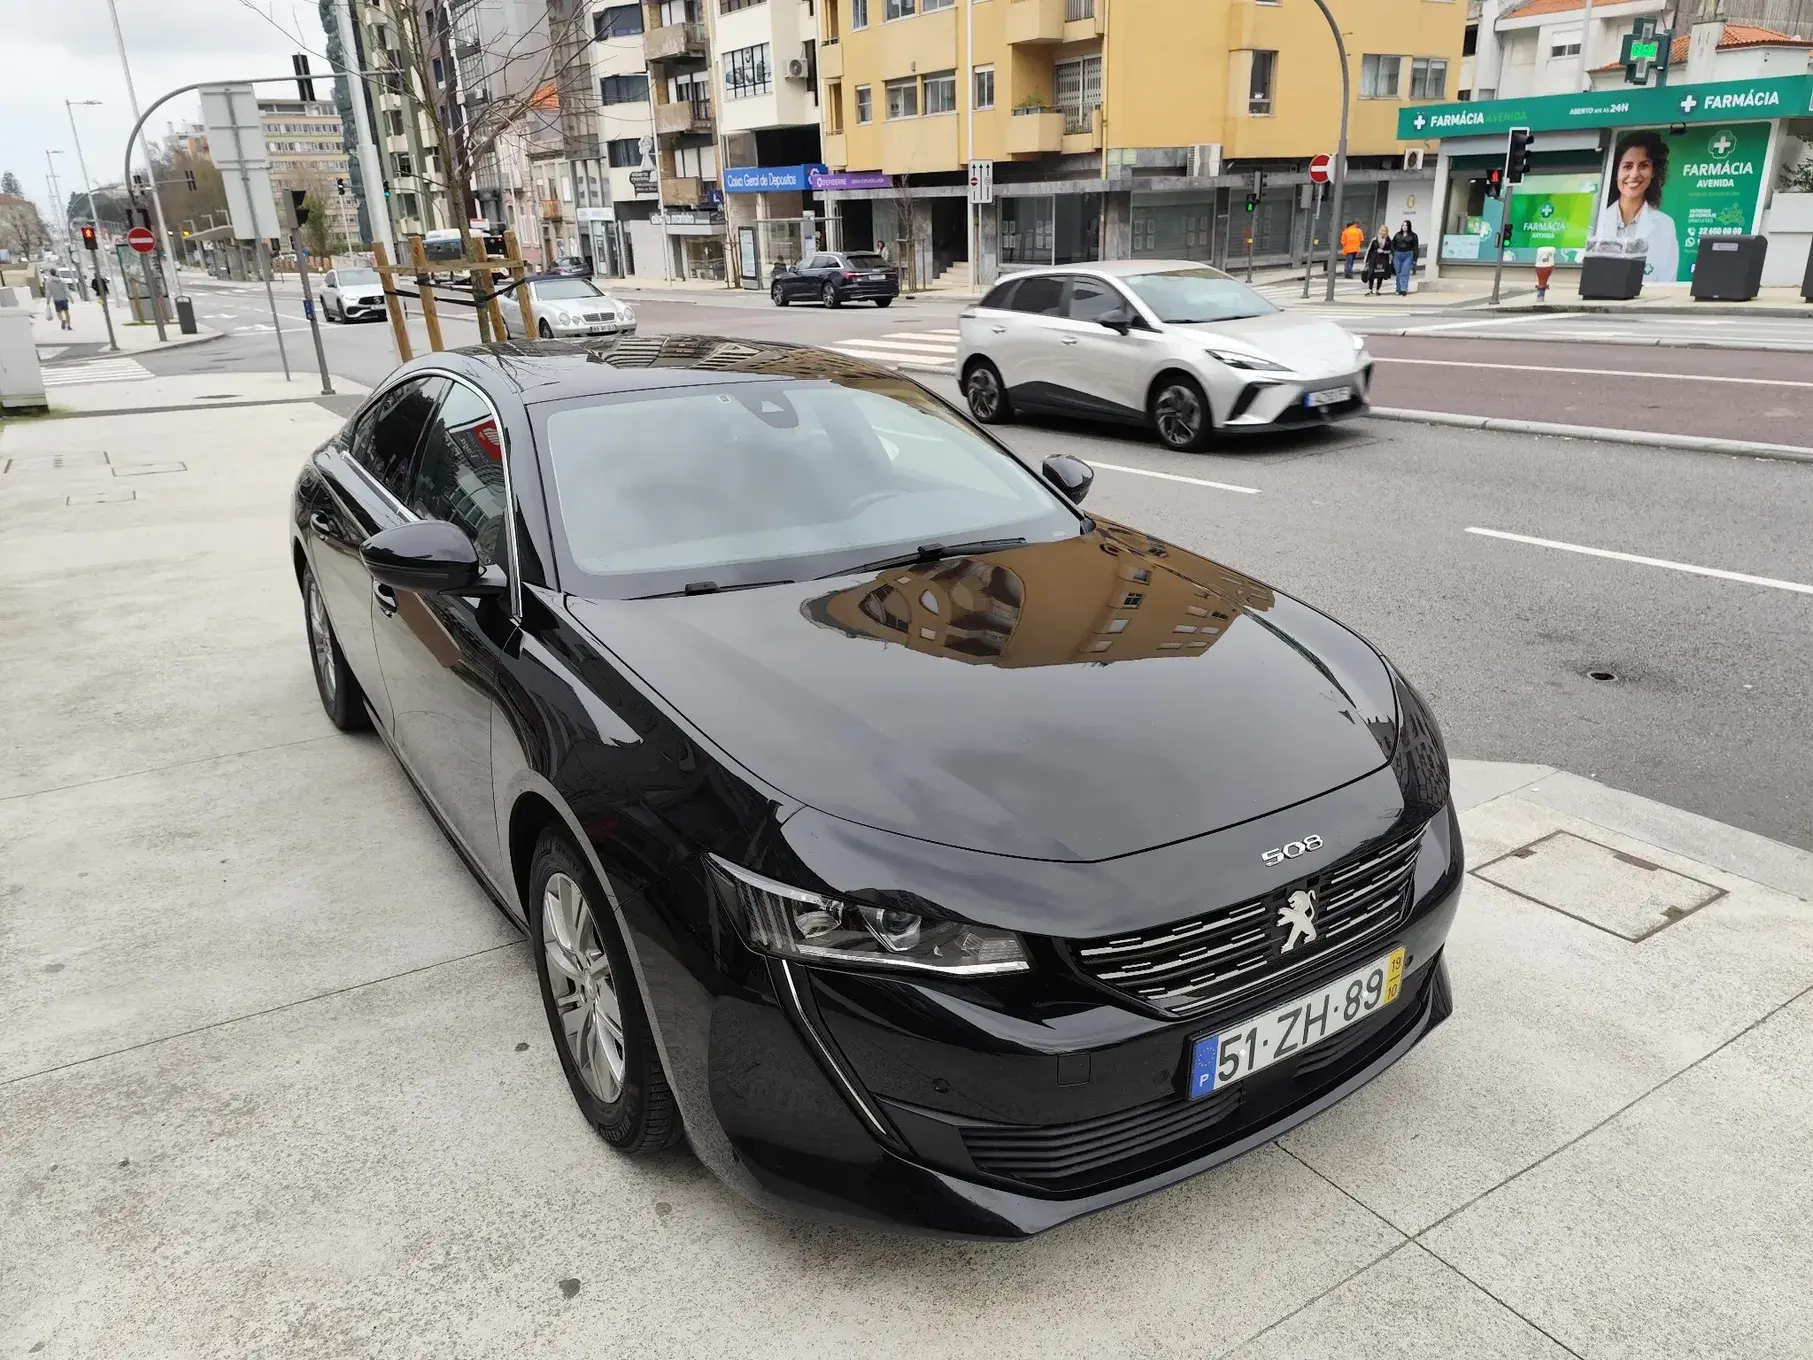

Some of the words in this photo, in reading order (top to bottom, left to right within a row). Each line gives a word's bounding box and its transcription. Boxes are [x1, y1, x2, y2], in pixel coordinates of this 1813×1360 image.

[1704, 89, 1779, 109] FARMÁCIA
[1569, 107, 1594, 115] ABERTO
[1610, 103, 1629, 113] 24H
[1430, 110, 1484, 127] FARMÁCIA
[1486, 111, 1527, 123] AVENIDA
[1683, 161, 1753, 176] FARMÁCIA
[727, 175, 743, 188] Caixa
[744, 173, 759, 187] Geral
[760, 174, 768, 186] de
[1696, 179, 1734, 188] AVENIDA
[1261, 834, 1324, 867] 508
[1390, 957, 1402, 974] 19
[1387, 985, 1398, 999] 10
[1199, 1073, 1209, 1087] P
